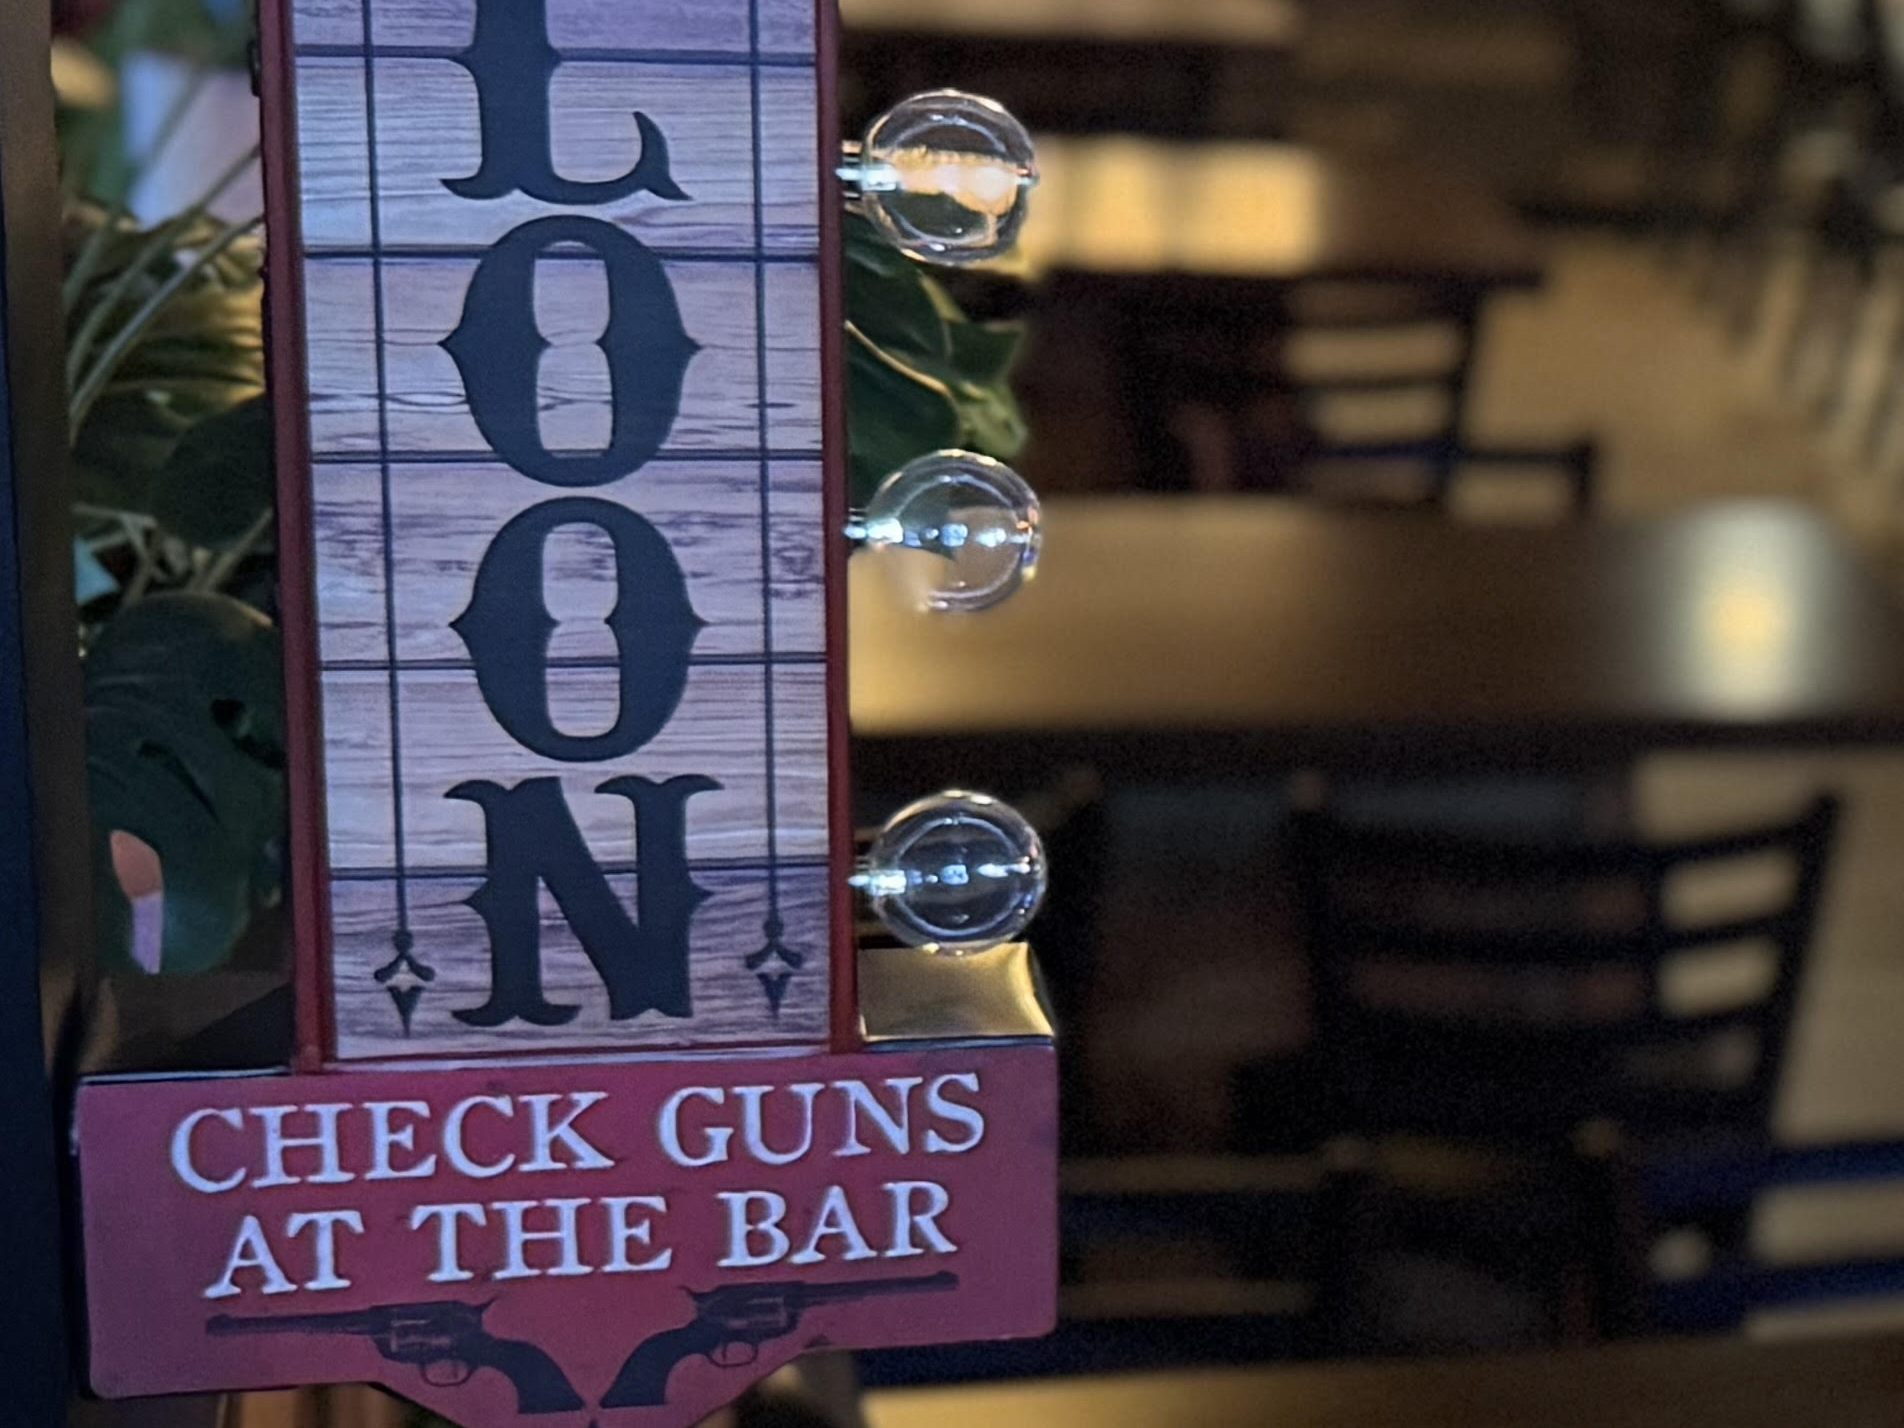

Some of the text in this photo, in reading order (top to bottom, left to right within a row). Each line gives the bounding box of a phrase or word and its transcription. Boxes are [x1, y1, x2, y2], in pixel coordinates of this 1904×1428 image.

[170, 1071, 987, 1194] CHECK GUNS
[203, 1179, 959, 1300] AT THE BAR
